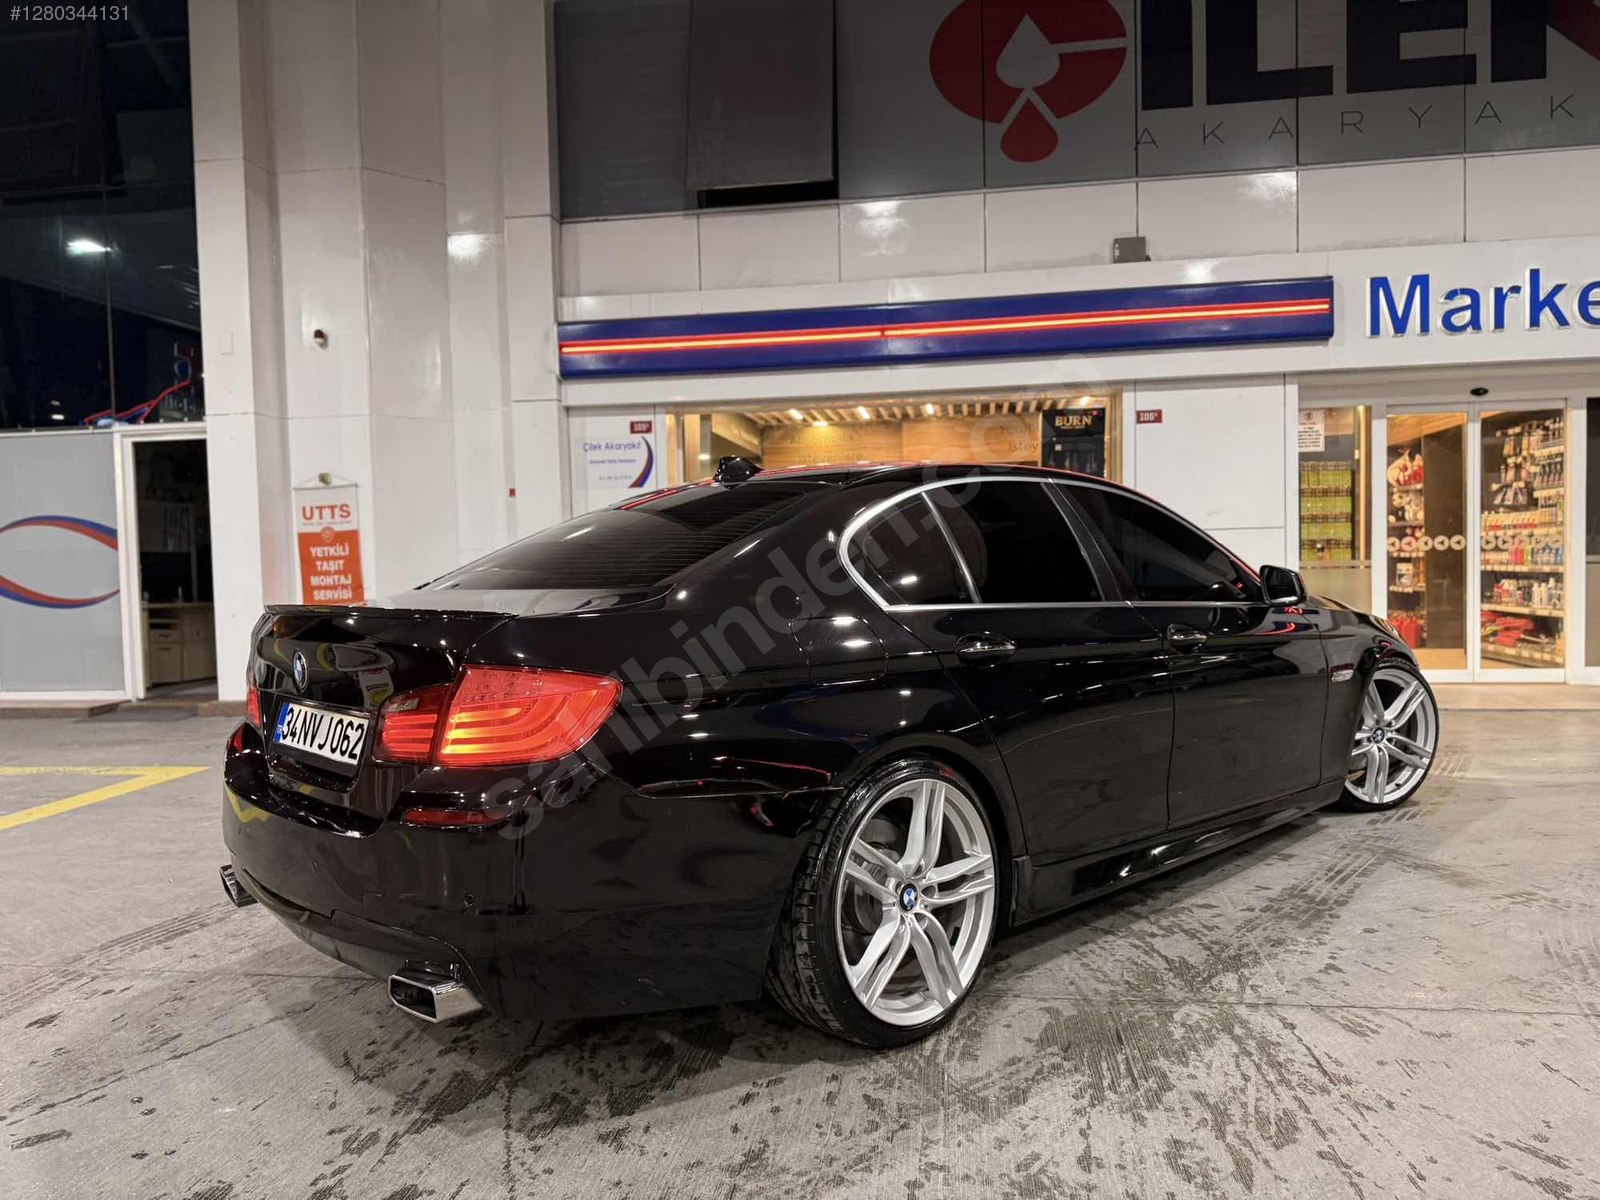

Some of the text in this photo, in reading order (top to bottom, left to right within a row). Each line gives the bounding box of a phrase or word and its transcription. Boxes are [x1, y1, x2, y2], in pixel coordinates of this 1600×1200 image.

[1136, 93, 1575, 149] AKARYAK
[1054, 415, 1093, 427] BURN
[302, 503, 351, 520] UTTS
[309, 543, 350, 557] YETKİLİ
[315, 560, 345, 573] TAŞIT
[310, 575, 352, 586] MONTAJ
[313, 586, 352, 600] SERVİSİ
